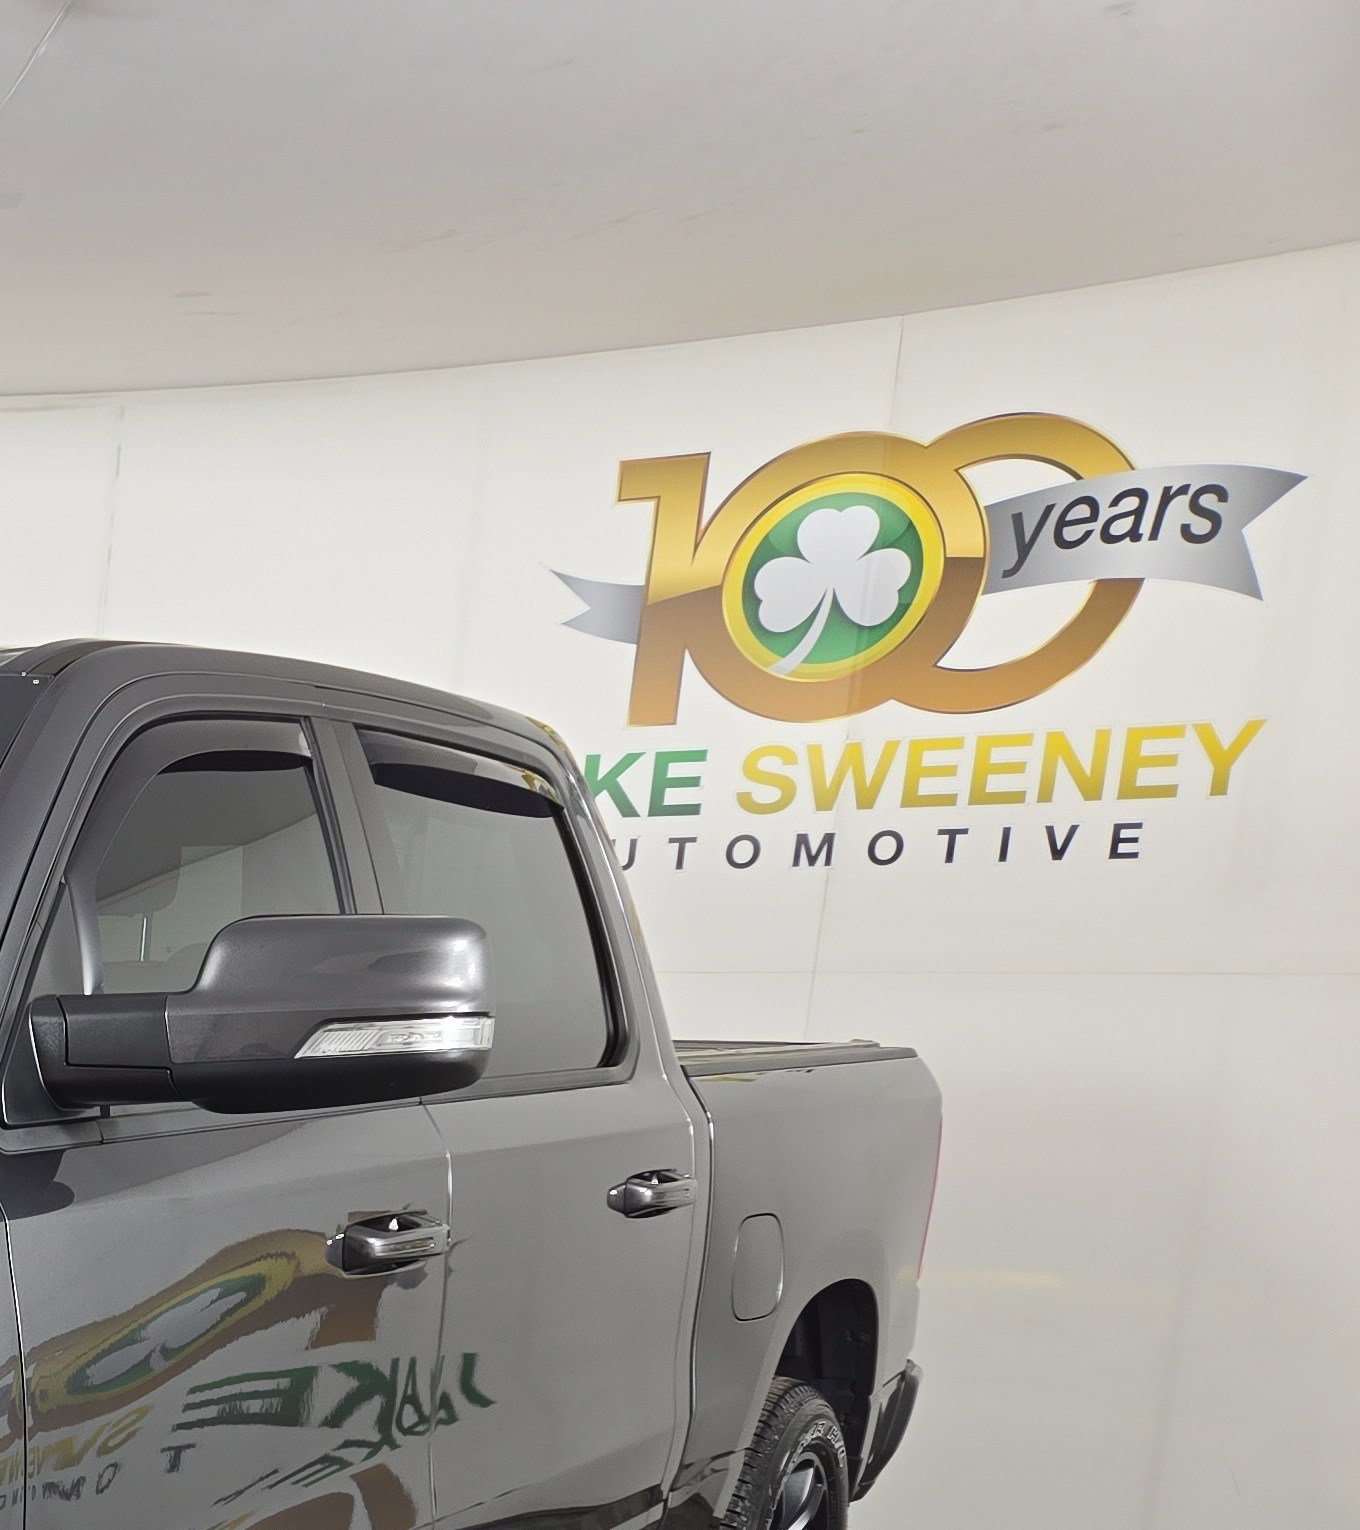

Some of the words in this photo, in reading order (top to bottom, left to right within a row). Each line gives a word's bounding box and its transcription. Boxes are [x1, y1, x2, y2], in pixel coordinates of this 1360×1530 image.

[615, 411, 1145, 728] 100
[1001, 482, 1229, 577] years
[583, 749, 709, 819] KE
[735, 718, 1266, 815] SWEENEY
